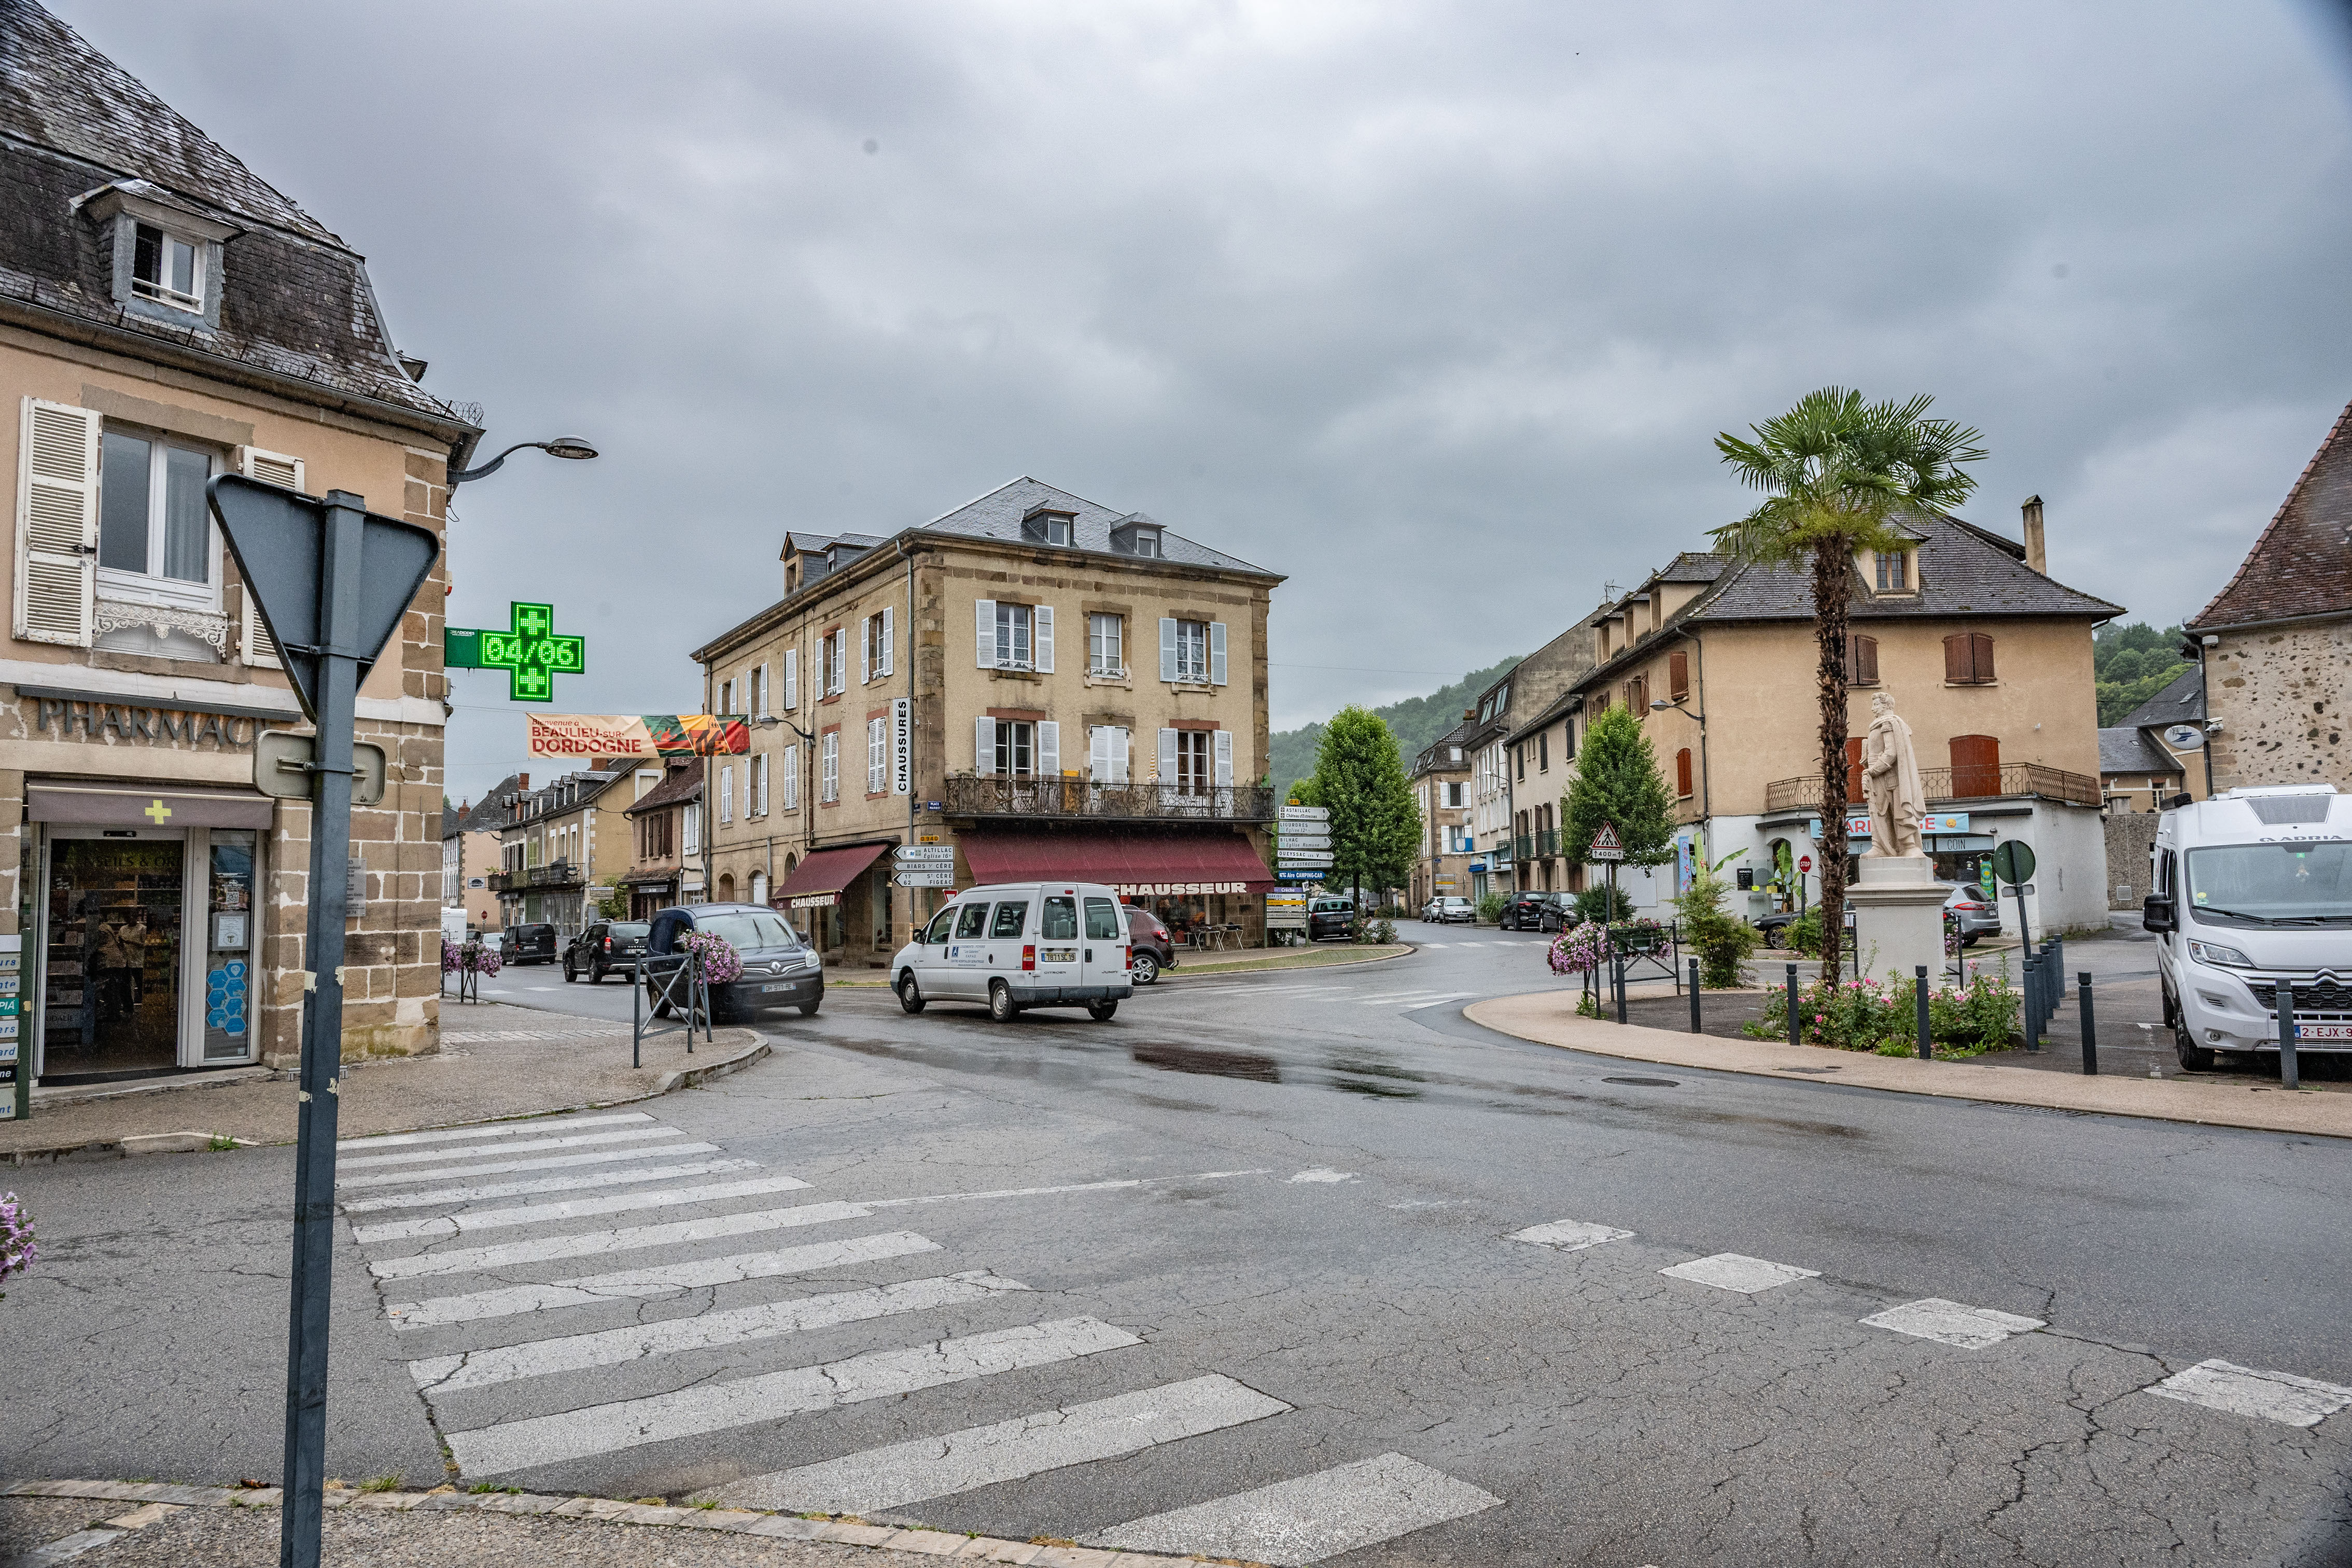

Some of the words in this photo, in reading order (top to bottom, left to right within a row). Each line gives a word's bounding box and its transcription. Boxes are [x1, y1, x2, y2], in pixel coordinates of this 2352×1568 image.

[487, 637, 573, 665] 04/06
[533, 738, 642, 753] DORDOGNE
[898, 701, 907, 791] CHAUSSURES
[1947, 839, 1966, 850] COIN
[791, 894, 835, 908] CHAUSSEUR
